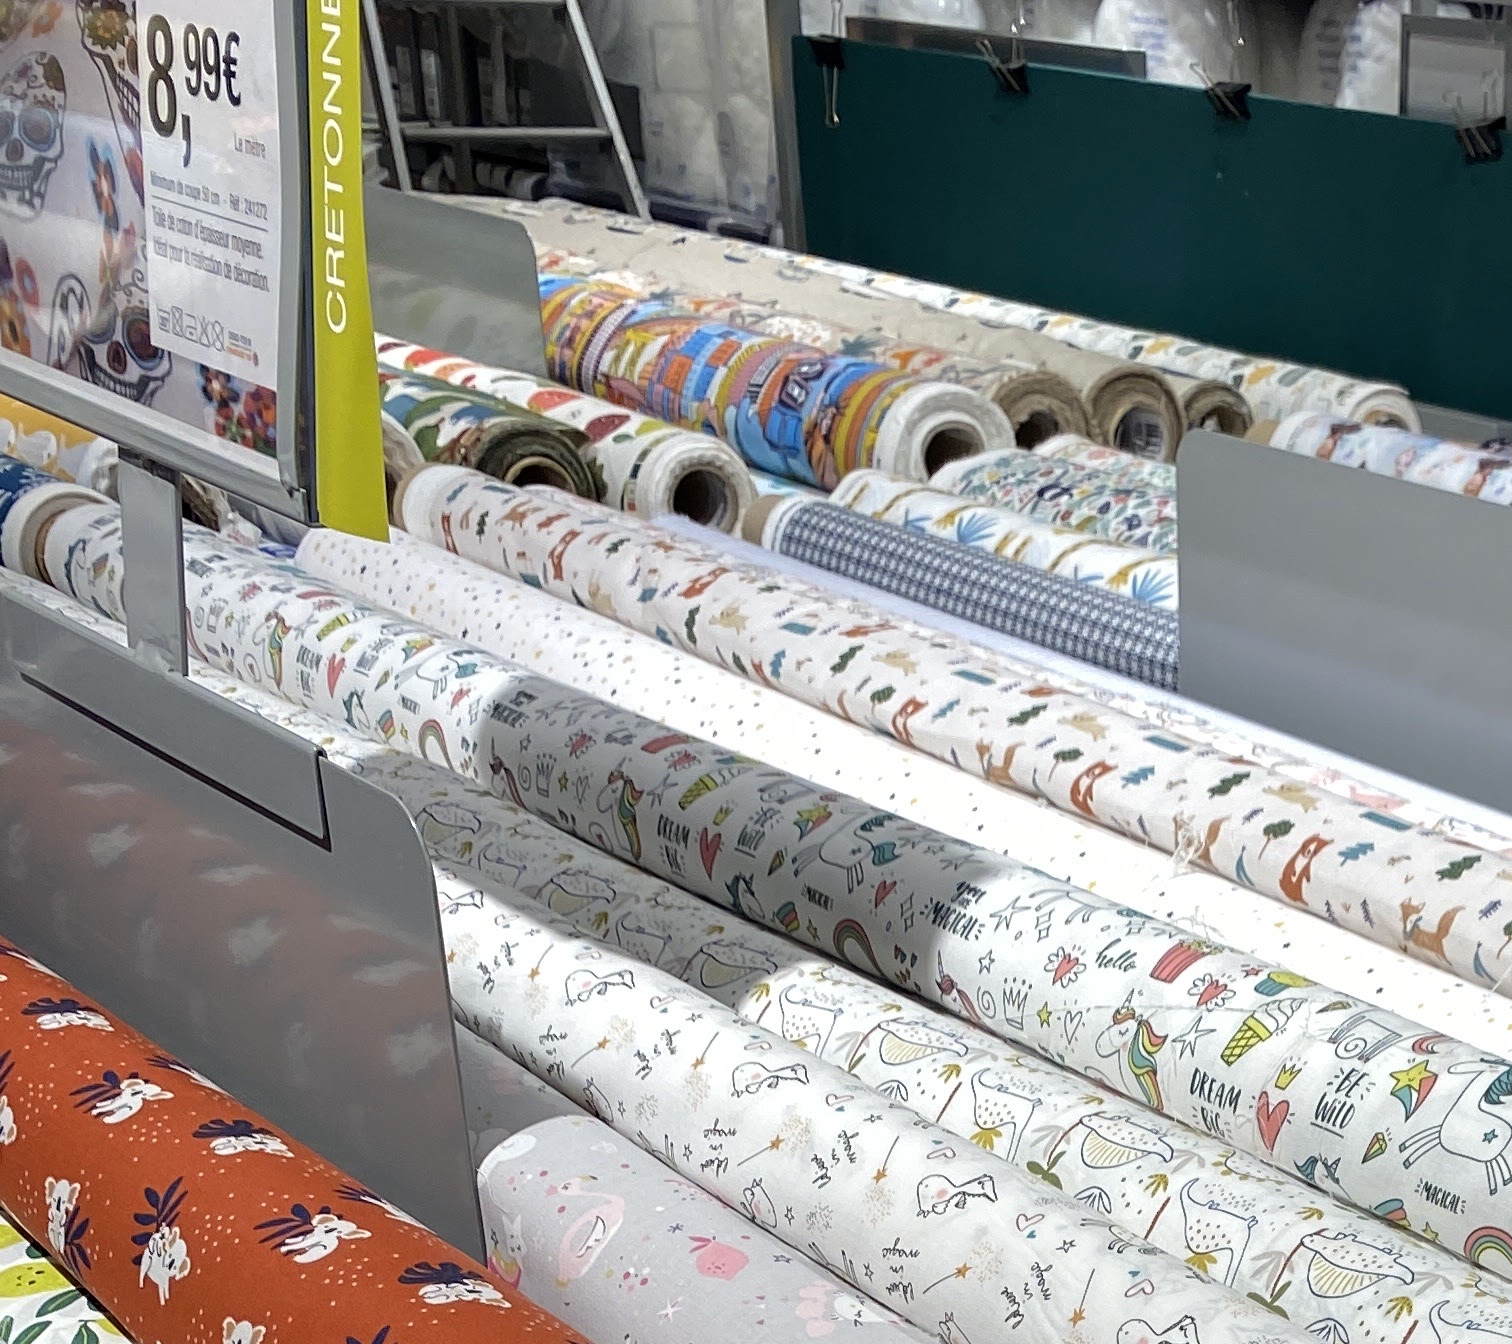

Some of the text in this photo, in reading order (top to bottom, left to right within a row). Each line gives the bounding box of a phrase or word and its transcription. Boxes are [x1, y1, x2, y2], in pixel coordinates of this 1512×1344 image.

[1096, 938, 1137, 972] hello
[1190, 1067, 1242, 1114] DREAM
[1420, 1181, 1461, 1214] MAGICAL
